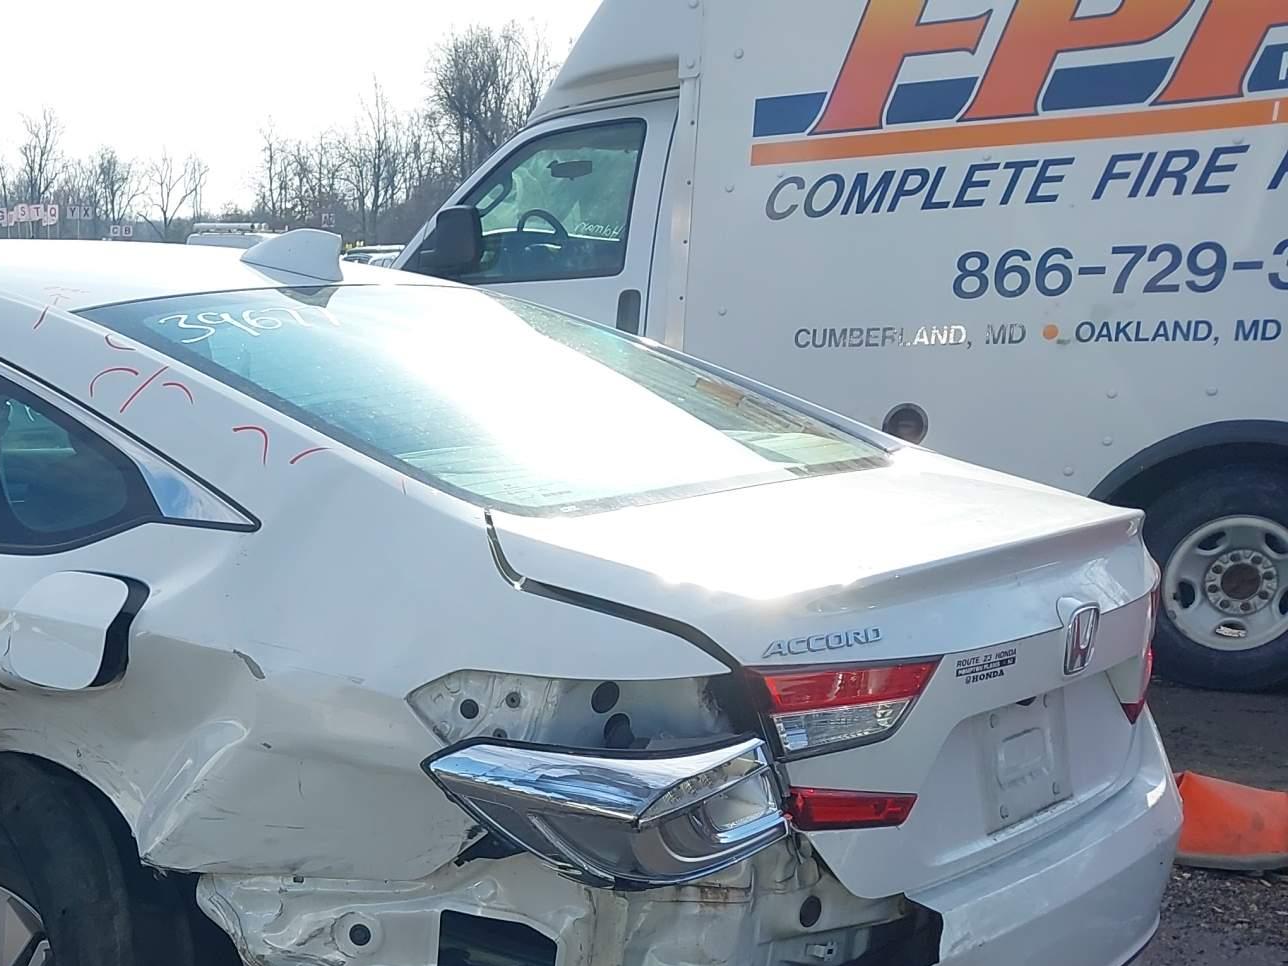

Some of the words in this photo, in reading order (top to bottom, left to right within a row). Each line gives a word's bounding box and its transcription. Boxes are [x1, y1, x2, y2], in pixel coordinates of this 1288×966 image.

[765, 156, 1076, 221] COMPLETE
[1091, 144, 1251, 200] FIRE
[985, 323, 1027, 345] MD
[1074, 320, 1220, 347] OAKLAND,
[1234, 319, 1281, 342] MD
[760, 625, 883, 658] ACCORD
[956, 655, 982, 668] ROUTE
[995, 648, 1017, 660] HONDA
[972, 668, 1005, 684] HONDA
